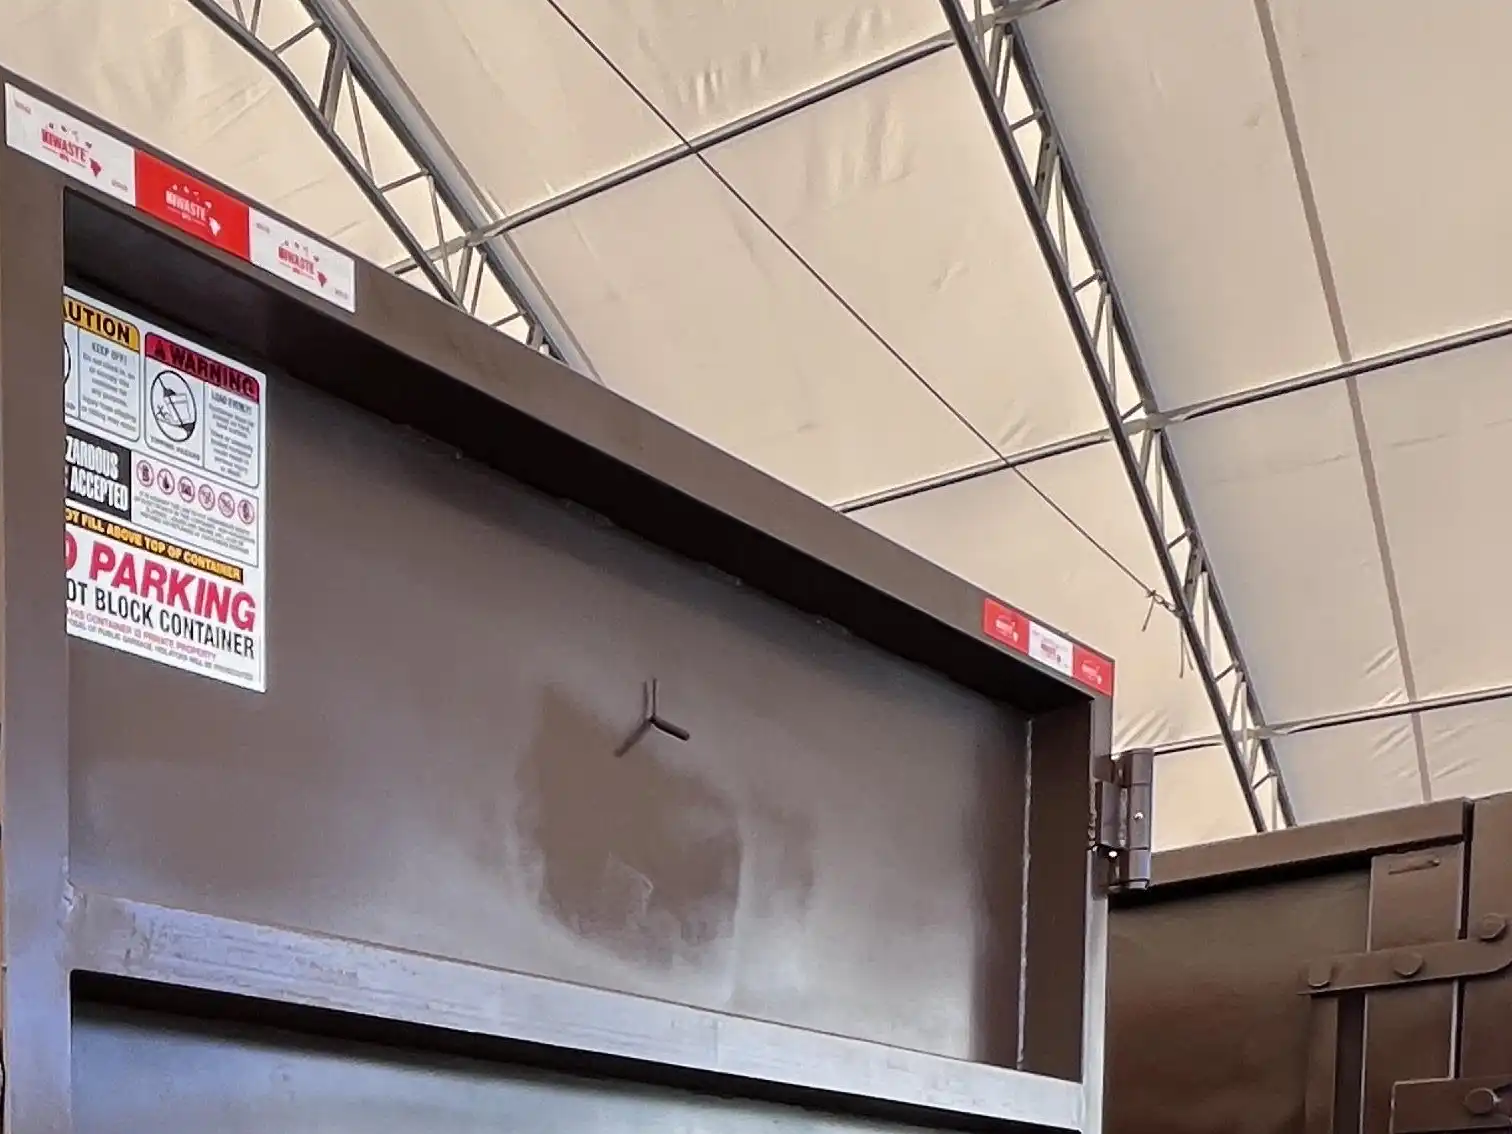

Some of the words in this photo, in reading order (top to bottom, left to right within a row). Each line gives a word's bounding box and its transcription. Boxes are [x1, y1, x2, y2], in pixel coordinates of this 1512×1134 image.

[92, 342, 109, 357] KEEP
[169, 344, 255, 396] WARNING
[70, 466, 129, 511] ACCEPTED
[81, 513, 104, 533] FILL
[106, 523, 142, 546] ABOVE
[145, 536, 166, 553] TOP
[167, 545, 182, 559] OF
[183, 551, 241, 580] CONTAINER
[89, 541, 256, 632] PARKING
[95, 587, 153, 628] BLOCK
[159, 609, 254, 660] CONTAINER
